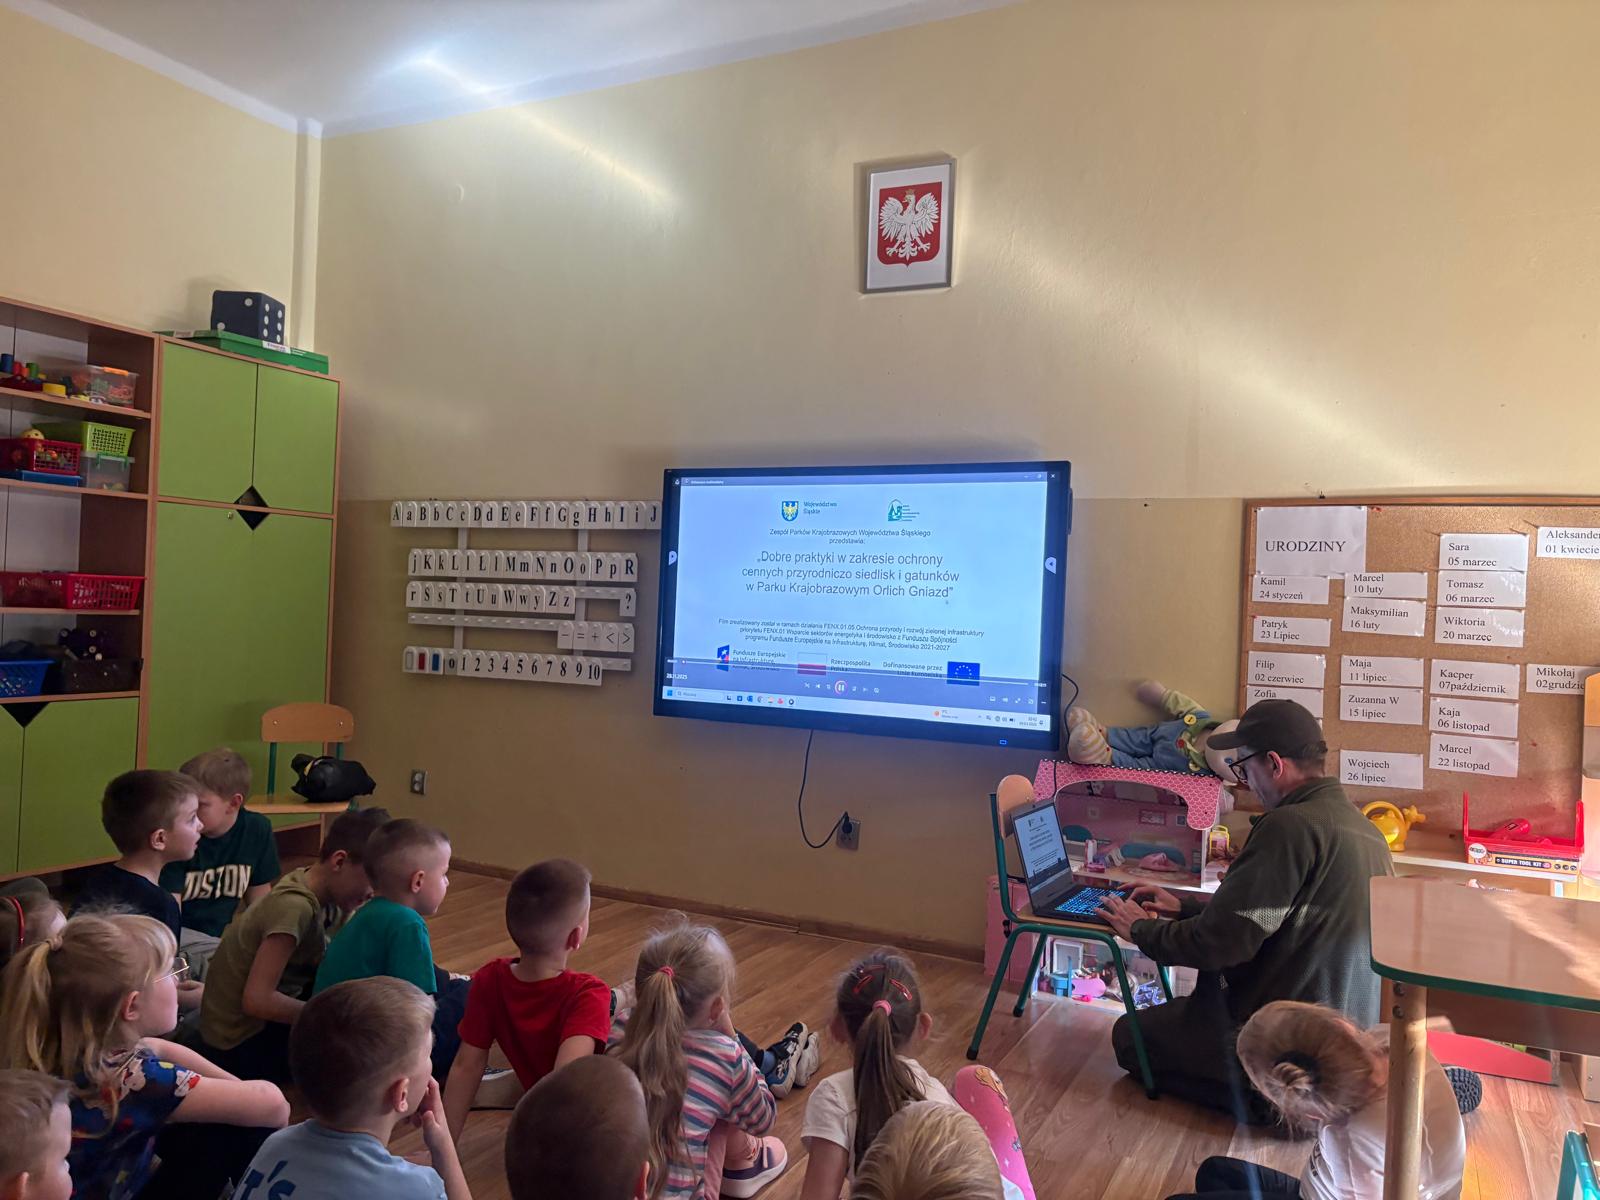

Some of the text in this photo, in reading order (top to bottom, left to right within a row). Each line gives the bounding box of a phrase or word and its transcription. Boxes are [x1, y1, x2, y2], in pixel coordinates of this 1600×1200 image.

[393, 506, 656, 526] A a B b C c D d E e F f G g H h I i J
[812, 529, 857, 537] Krajobrazowych
[901, 529, 931, 537] Śląskiego
[1265, 541, 1346, 552] URODZINY
[1448, 543, 1469, 551] Sara
[1545, 544, 1556, 553] 01
[795, 552, 834, 565] praktyki
[838, 555, 846, 563] w
[849, 553, 894, 564] zakresie
[898, 553, 943, 567] ochrony
[1448, 557, 1496, 567] 05 marzec
[412, 555, 416, 573] j
[424, 554, 432, 569] K
[439, 554, 444, 570] k
[452, 555, 458, 570] L
[506, 556, 516, 572] M
[520, 562, 529, 572] m
[536, 556, 545, 572] N
[550, 563, 556, 573] n
[564, 557, 574, 573] O
[580, 563, 586, 574] o
[595, 558, 602, 574] P
[610, 564, 617, 579] p
[625, 558, 634, 575] R
[742, 568, 783, 579] cennych
[787, 568, 852, 580] przyrodniczo
[855, 569, 895, 580] siedlisk
[905, 570, 959, 582] gatunków
[1353, 574, 1384, 582] Marcel
[1261, 578, 1286, 586] Kamil
[1446, 580, 1484, 588] Tomasz
[746, 583, 754, 591] w
[758, 582, 786, 592] Parku
[790, 583, 869, 597] Krajobrazowym
[873, 585, 904, 596] Orlich
[1353, 585, 1383, 595] 10 luty
[411, 587, 631, 610] r S s T t U u W w y Z z ?
[1272, 592, 1303, 600] styczeń
[1446, 594, 1458, 602] 06
[1350, 606, 1408, 618] Maksymilian
[1261, 620, 1288, 629] Patryk
[1350, 620, 1380, 630] 16 luty
[1444, 616, 1485, 626] Wiktoria
[1260, 631, 1300, 642] 23 Lipiec
[1443, 631, 1492, 641] 20 marzec
[462, 657, 466, 671] 1
[475, 657, 480, 671] 2
[488, 657, 494, 672] 3
[502, 657, 508, 673] 4
[517, 658, 523, 673] 5
[531, 659, 537, 675] 6
[547, 660, 553, 675] 7
[560, 661, 567, 677] 8
[576, 662, 582, 678] 9
[588, 664, 600, 680] 10
[1256, 660, 1274, 669] Filip
[1349, 659, 1372, 668] Maja
[1362, 673, 1387, 683] lipiec
[1440, 670, 1473, 680] Kacper
[1536, 668, 1575, 679] Mikołaj
[1255, 674, 1304, 684] 02 czerwiec
[1439, 681, 1506, 694] 07październik
[1254, 690, 1276, 698] Zofia
[1348, 695, 1386, 704] Zuzanna
[1362, 709, 1386, 719] lipiec
[1438, 707, 1460, 717] Kaja
[1438, 719, 1490, 732] 06 listopad
[1439, 743, 1472, 754] Marcel
[1348, 759, 1390, 770] Wojciech
[1438, 758, 1490, 771] 22 listopad
[1347, 773, 1386, 784] 26 lipiec
